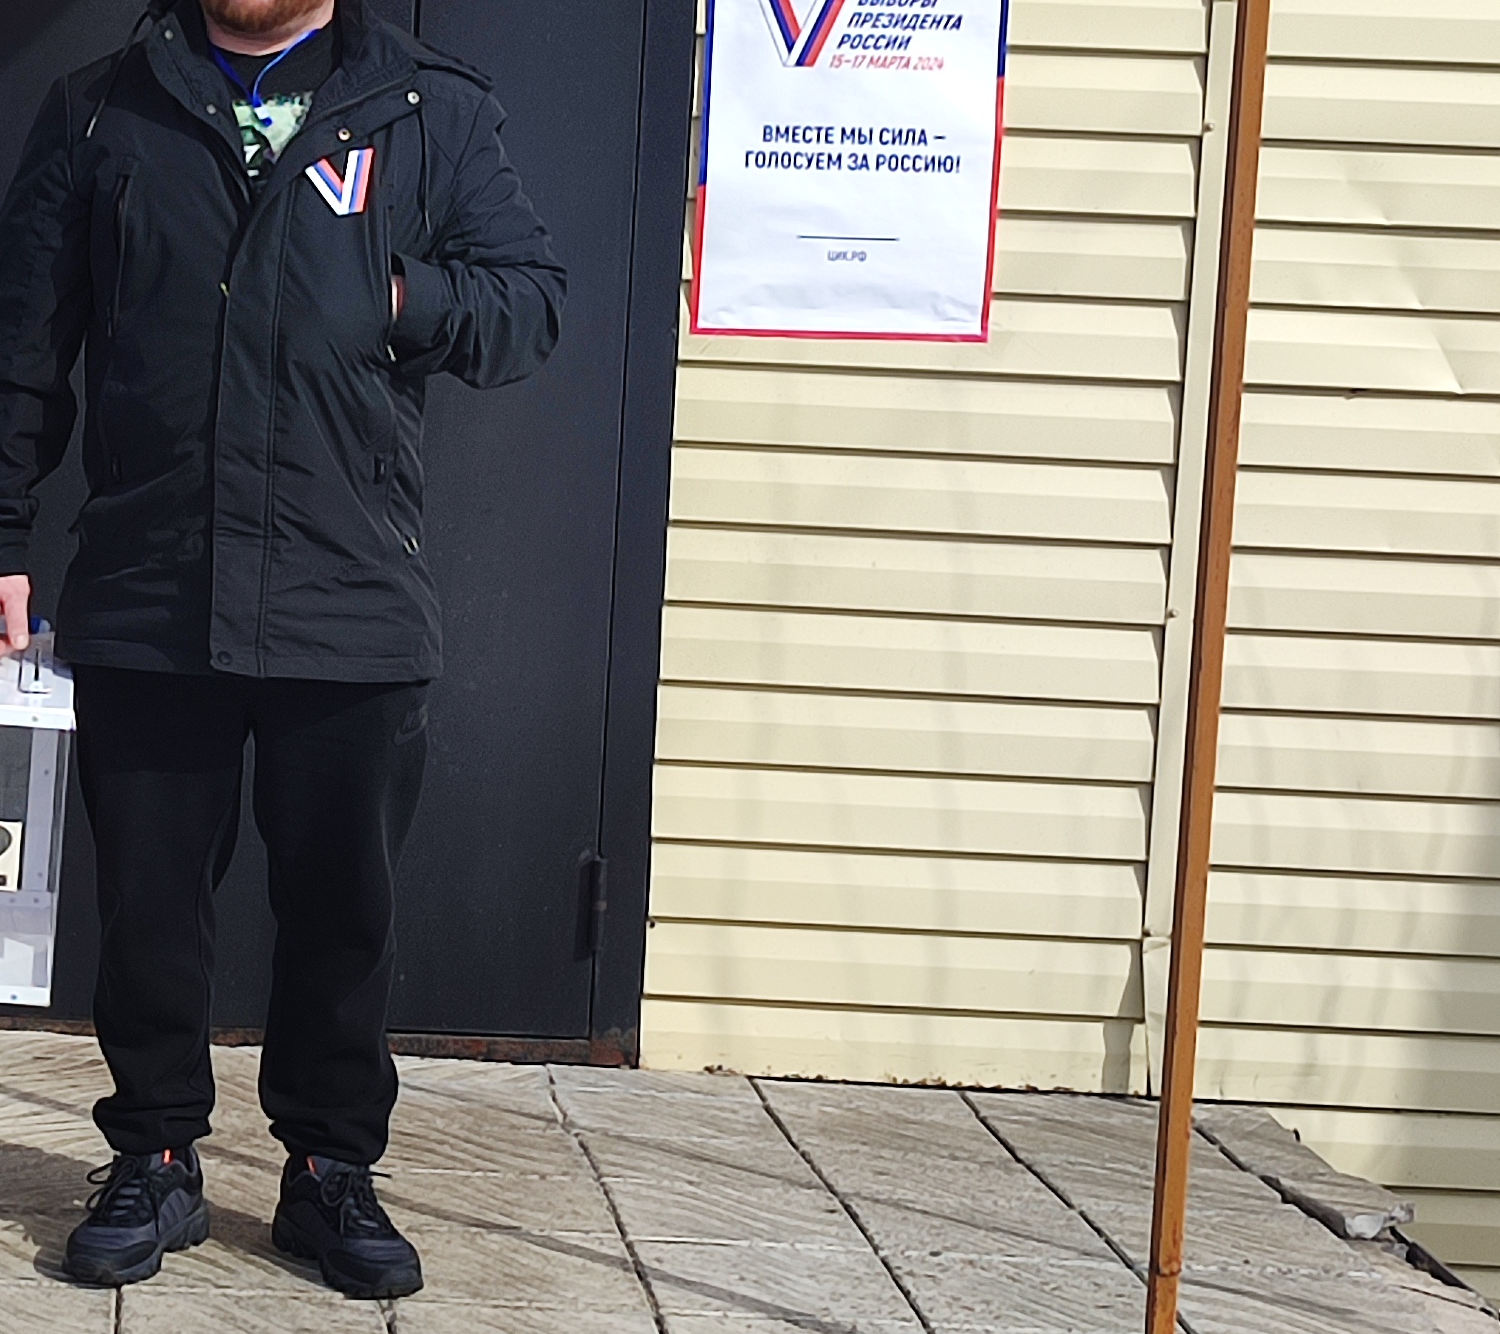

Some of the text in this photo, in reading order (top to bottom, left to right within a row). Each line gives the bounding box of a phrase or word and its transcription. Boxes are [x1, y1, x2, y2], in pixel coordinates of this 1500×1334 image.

[846, 12, 964, 32] ПРЕЗИДЕНТА
[836, 33, 913, 51] РОССИИ
[866, 55, 912, 70] МАРТА
[912, 56, 945, 71] 2024
[762, 125, 835, 144] ВМЕСТЕ
[840, 126, 874, 146] МЫ
[878, 127, 928, 147] СИЛА
[745, 150, 961, 174] ГОЛОСУЕМ ЗА РОССИЮ!
[827, 250, 867, 262] ЦИК.РФ
